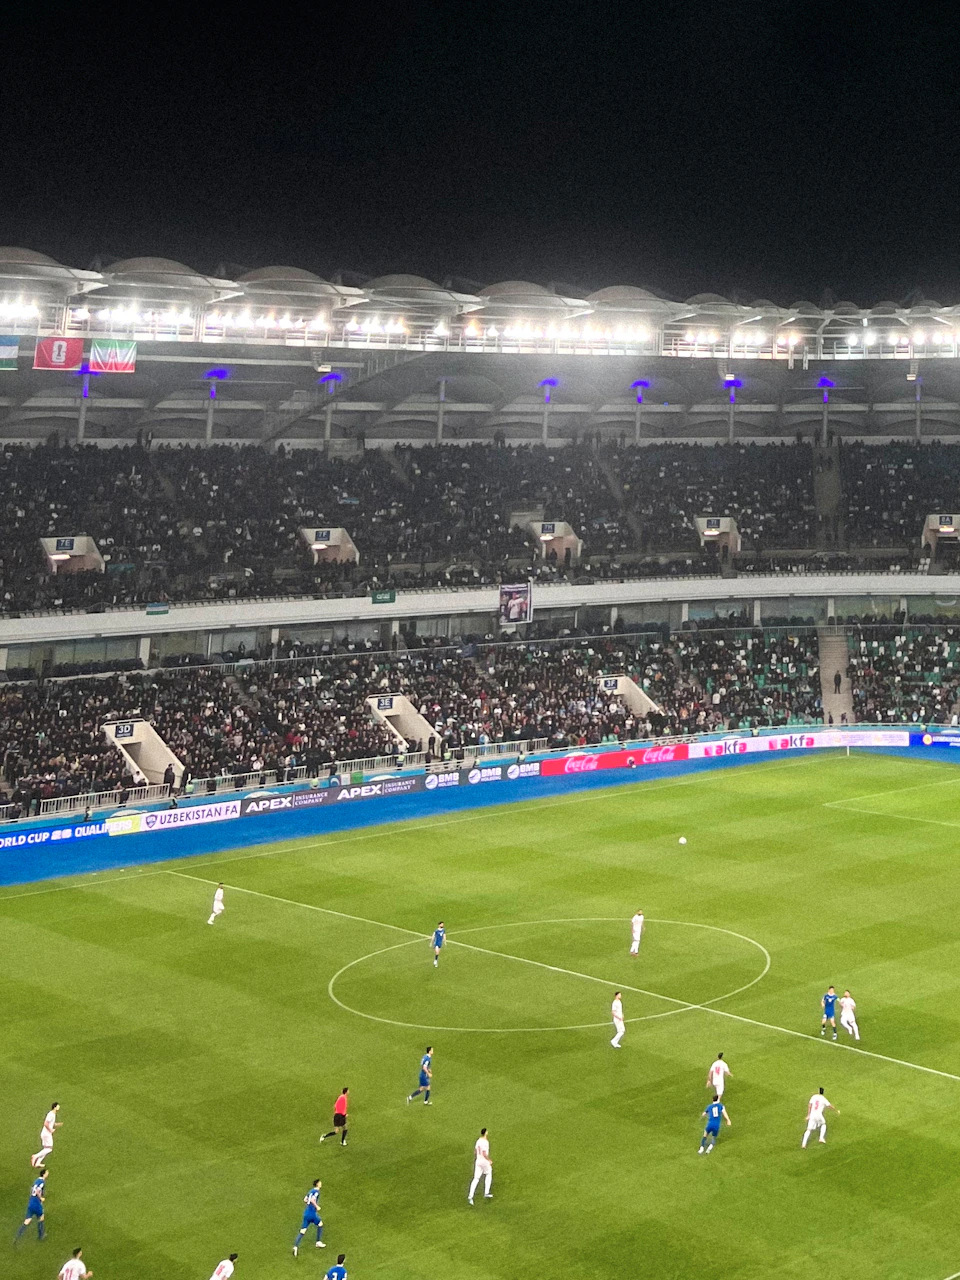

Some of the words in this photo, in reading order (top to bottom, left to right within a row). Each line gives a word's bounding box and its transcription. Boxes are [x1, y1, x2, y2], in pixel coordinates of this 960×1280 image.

[118, 725, 131, 733] 3D
[780, 735, 815, 750] akfa
[715, 741, 747, 756] akfa
[481, 767, 502, 777] BMB
[519, 762, 540, 773] BMB
[438, 772, 459, 782] BMB
[384, 785, 411, 793] COMPANY
[385, 779, 416, 789] INSURANCE
[295, 791, 328, 801] INSURANCE
[336, 784, 382, 800] APEX
[245, 796, 292, 813] APEX
[294, 797, 323, 806] COMPANY
[159, 807, 222, 825] UZBEKISTAN
[224, 805, 238, 815] FA
[0, 835, 26, 848] ORLD
[27, 832, 50, 844] CUP
[74, 819, 133, 837] QUALIFIERS
